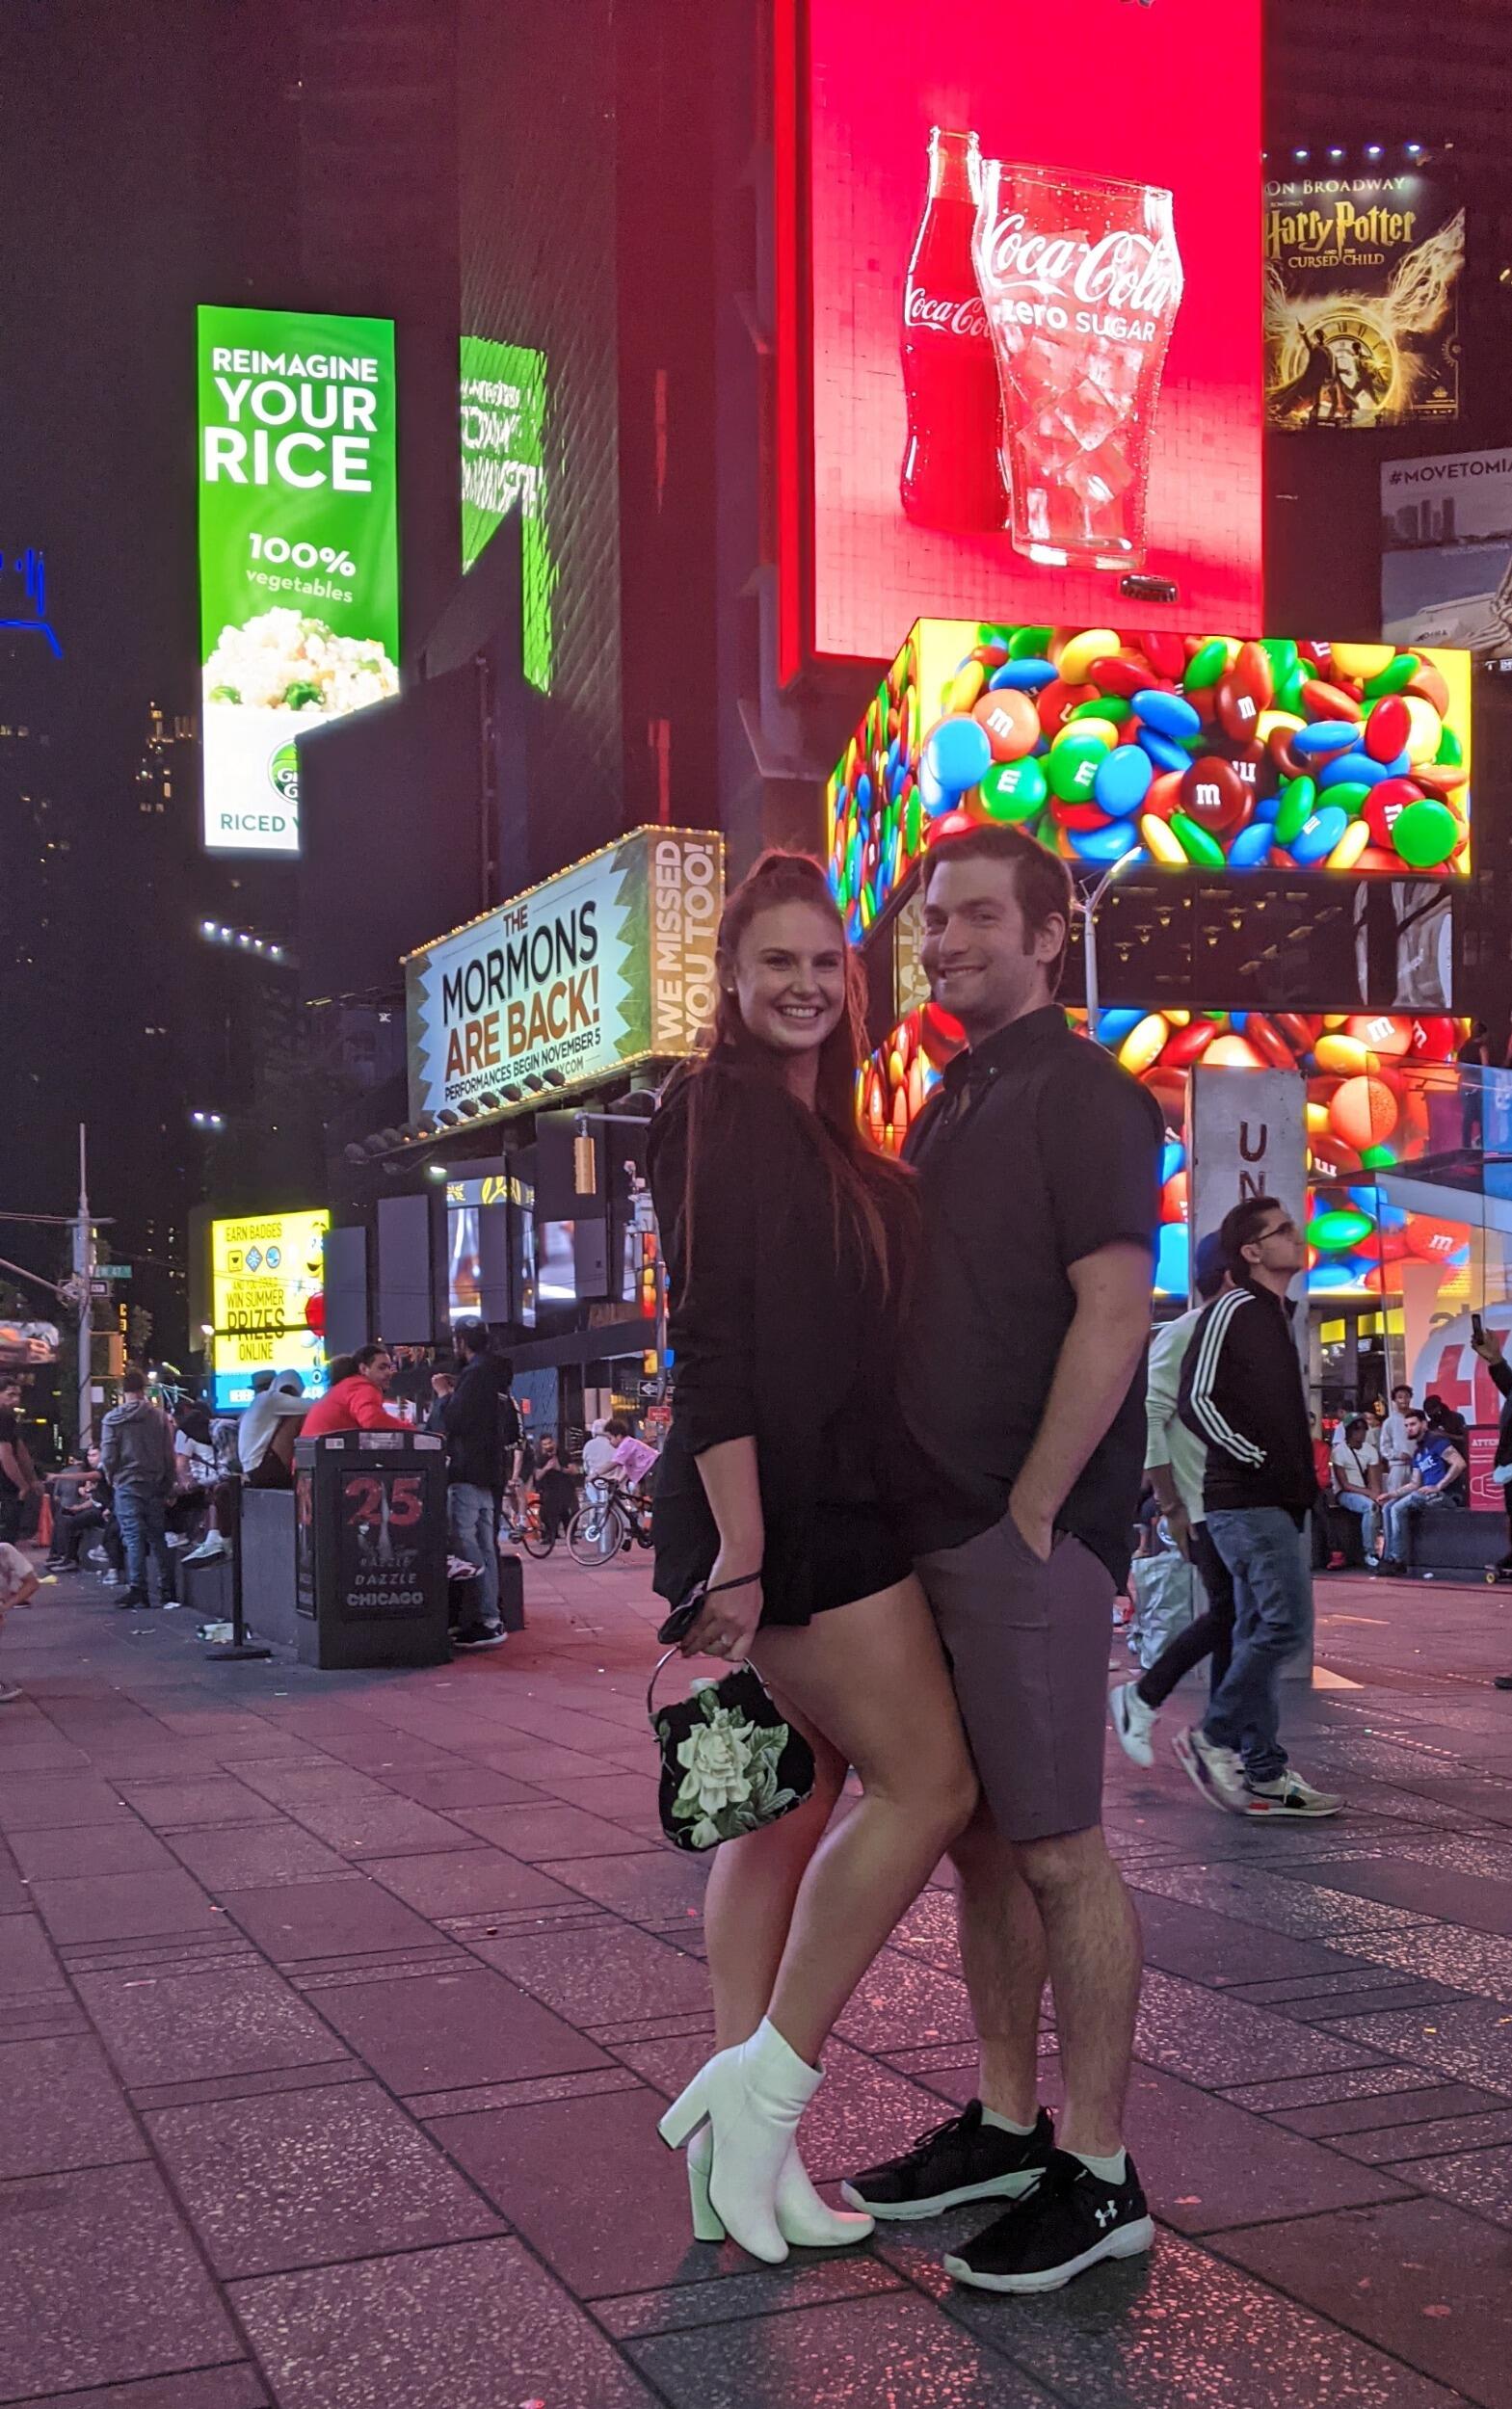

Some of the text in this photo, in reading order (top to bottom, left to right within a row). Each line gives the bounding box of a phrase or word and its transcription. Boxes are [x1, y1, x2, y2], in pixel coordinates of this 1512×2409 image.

[1265, 177, 1406, 197] ON BROADWAY
[1264, 200, 1417, 260] Harry Potter
[1288, 253, 1385, 269] CURSED CHILD
[905, 287, 993, 338] Coca-Co
[1075, 310, 1156, 342] SUGAR
[212, 347, 379, 383] REIMAGINE
[214, 377, 378, 432] YOUR
[204, 426, 372, 492] RICE
[249, 532, 357, 577] 100%
[246, 569, 354, 603] vegetables
[1196, 782, 1221, 806] m
[220, 813, 286, 833] RICED
[503, 904, 529, 938] THE
[655, 839, 683, 1042] WE MISSED
[683, 841, 716, 1044] YOU TOO!
[442, 900, 598, 1027] MORMONS
[445, 1010, 501, 1083] ARE
[507, 965, 600, 1059] BACK!
[444, 1064, 512, 1102] PERFORMANCES
[514, 1055, 540, 1077] BEGIN
[542, 1031, 594, 1066] NOVEMBER
[595, 1027, 601, 1046] 5
[225, 1222, 282, 1242] EARN BADGES
[226, 1289, 284, 1308] WIN SUMMER
[227, 1308, 285, 1341] PRIZES
[239, 1341, 274, 1361] ONLINE
[345, 1477, 424, 1526] 25
[355, 1573, 417, 1586] DAZZLE
[346, 1591, 424, 1607] CHICAGO
